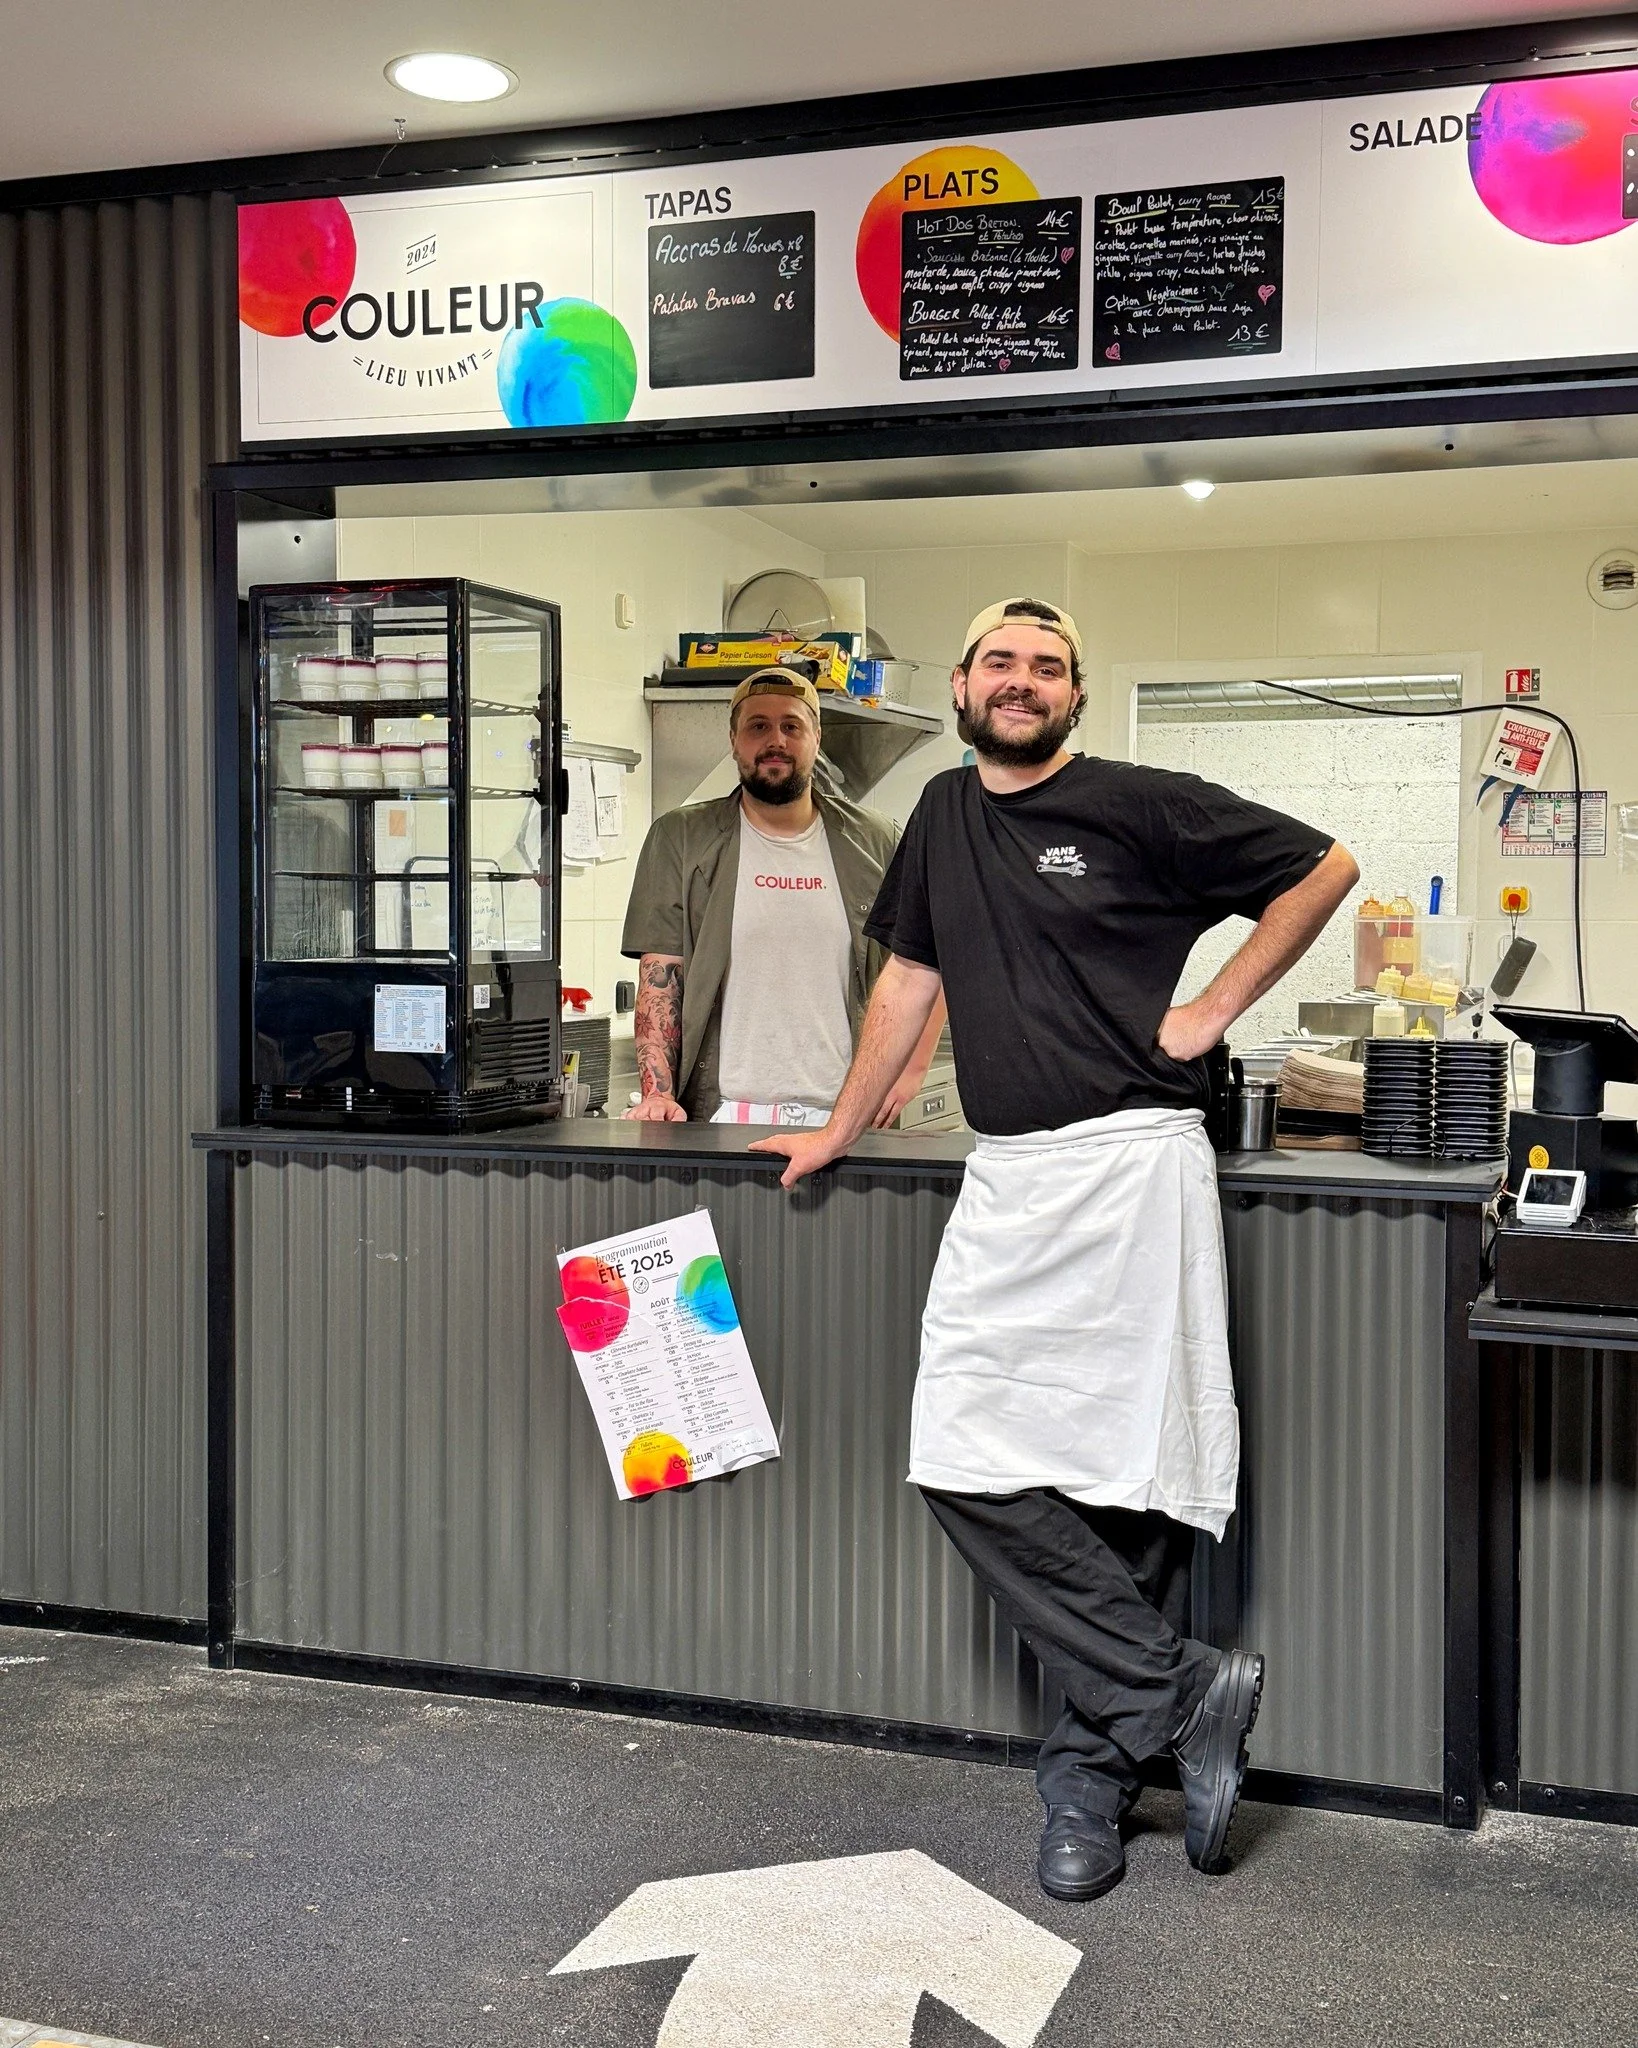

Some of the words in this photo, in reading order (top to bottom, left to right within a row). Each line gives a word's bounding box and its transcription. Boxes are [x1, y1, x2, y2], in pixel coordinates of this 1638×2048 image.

[1349, 111, 1482, 151] SALADE
[904, 167, 999, 201] PLATS
[645, 186, 732, 219] TAPAS
[1178, 196, 1202, 209] curry
[1206, 192, 1231, 205] Rouge
[917, 219, 943, 234] HOT
[946, 215, 973, 231] DOG
[655, 234, 720, 264] Accras
[723, 230, 738, 254] de
[1204, 234, 1216, 244] riz
[406, 240, 436, 267] 2024
[988, 281, 1012, 294] crispy
[652, 291, 698, 315] Patatas
[705, 287, 756, 311] Bravas
[1105, 295, 1140, 311] Option
[302, 281, 544, 343] COULEUR
[908, 300, 960, 324] BURGER
[1133, 307, 1153, 318] avec
[366, 359, 407, 387] LIEU
[417, 353, 479, 387] VIVANT
[720, 651, 742, 660] Papier
[744, 651, 772, 659] Cuisson
[1045, 846, 1076, 856] VANS
[755, 875, 826, 889] COULEUR.
[595, 1236, 668, 1266] programmation
[599, 1259, 626, 1285] ÉTÉ
[631, 1250, 674, 1275] 2025
[650, 1296, 671, 1309] AOÛT
[580, 1316, 606, 1331] JUILLET
[672, 1451, 714, 1470] COULEUR
